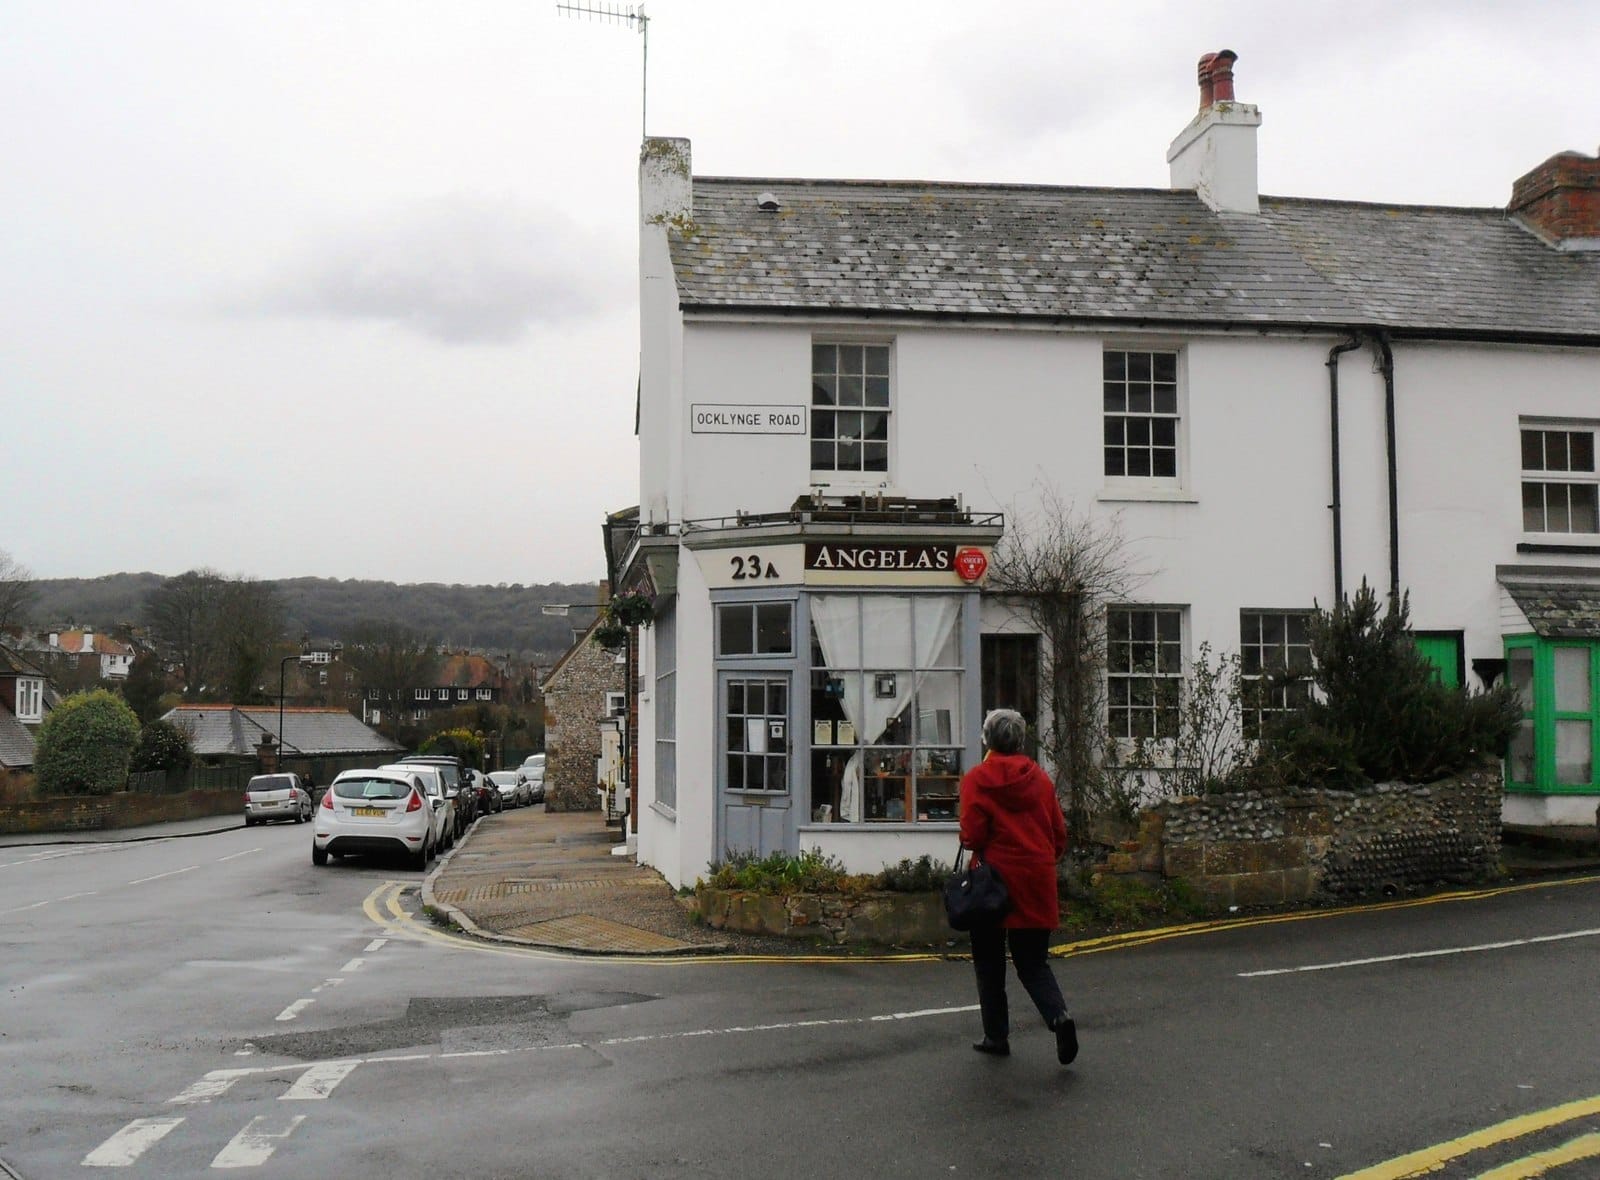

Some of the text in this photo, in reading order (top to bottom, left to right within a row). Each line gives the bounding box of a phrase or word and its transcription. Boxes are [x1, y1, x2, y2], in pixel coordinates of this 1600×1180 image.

[697, 413, 801, 426] OCKLYNGE ROAD
[731, 555, 780, 580] 23A
[813, 545, 949, 569] ANGELA'S
